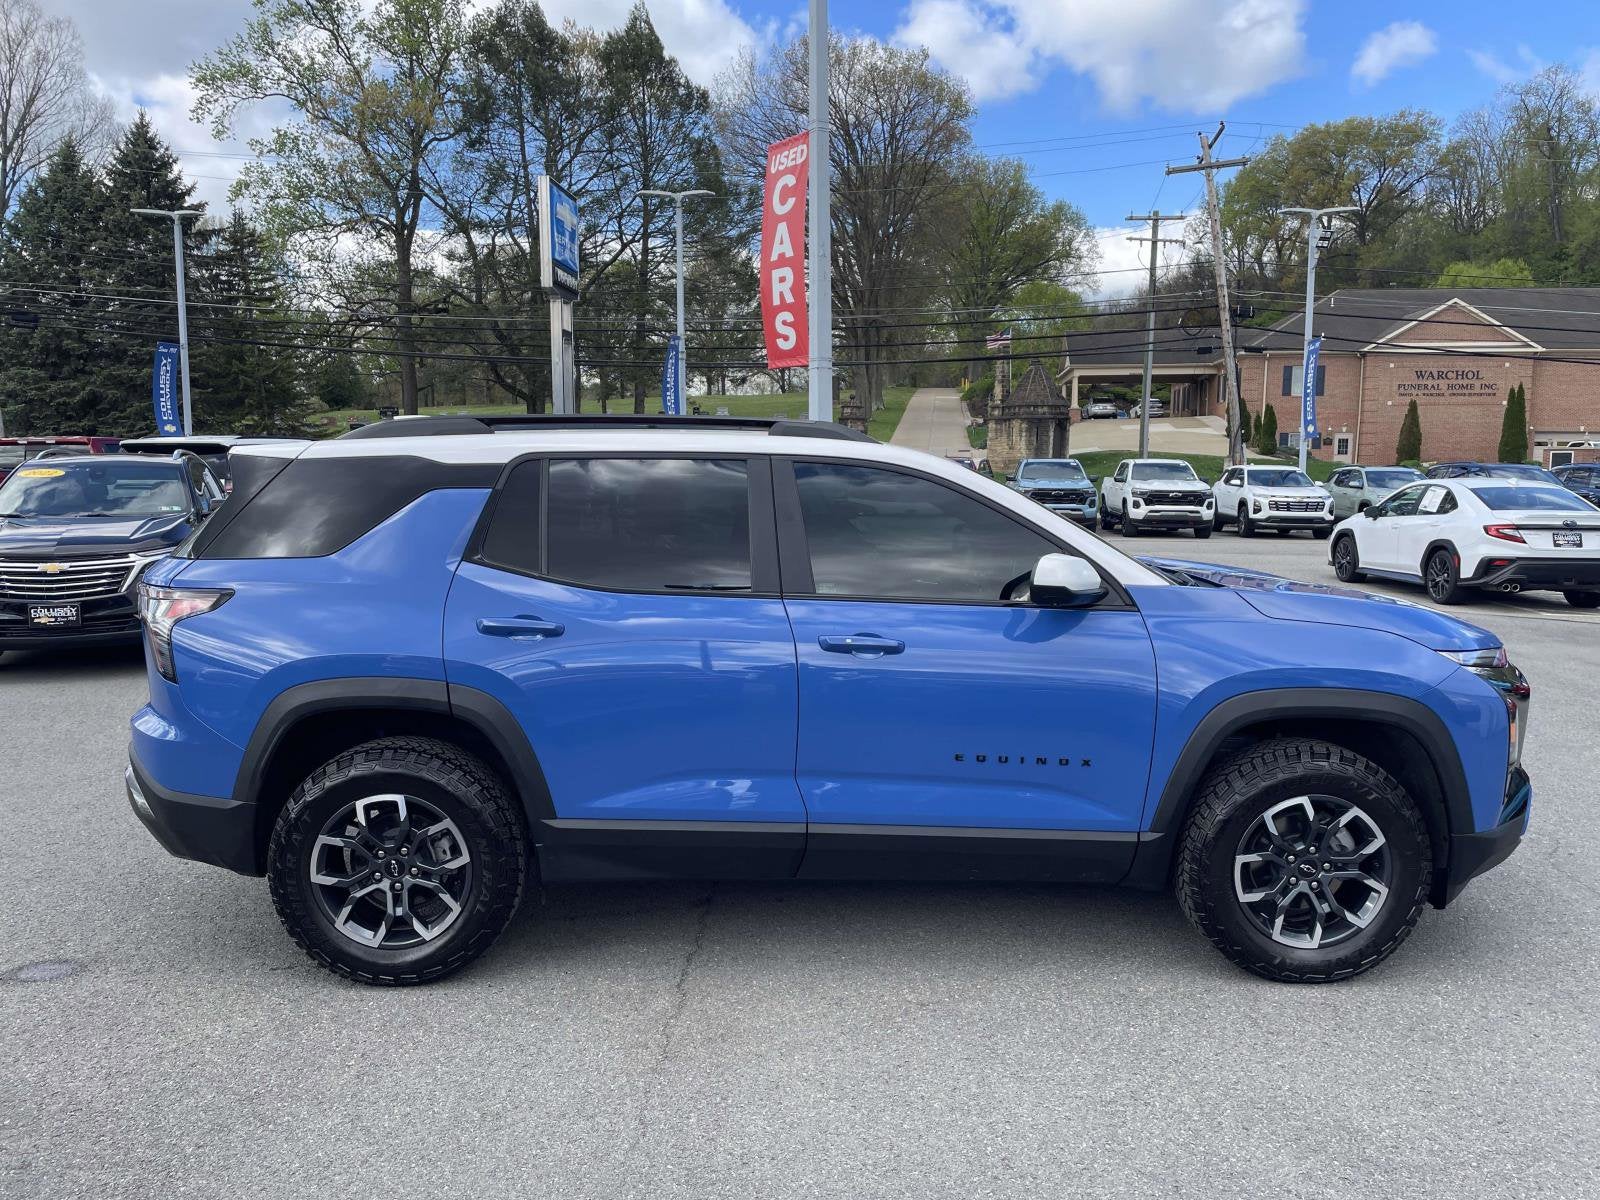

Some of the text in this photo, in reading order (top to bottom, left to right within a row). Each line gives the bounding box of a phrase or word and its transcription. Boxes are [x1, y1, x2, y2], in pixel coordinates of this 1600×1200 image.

[770, 143, 808, 174] USED
[770, 174, 797, 351] CARS
[159, 356, 168, 420] COLUSSY
[165, 357, 173, 420] CHEVROLET
[1397, 383, 1442, 391] FUNERAL
[1446, 383, 1475, 391] HOME
[1414, 370, 1484, 380] WARCHOL
[954, 753, 1092, 767] EQUINOX
